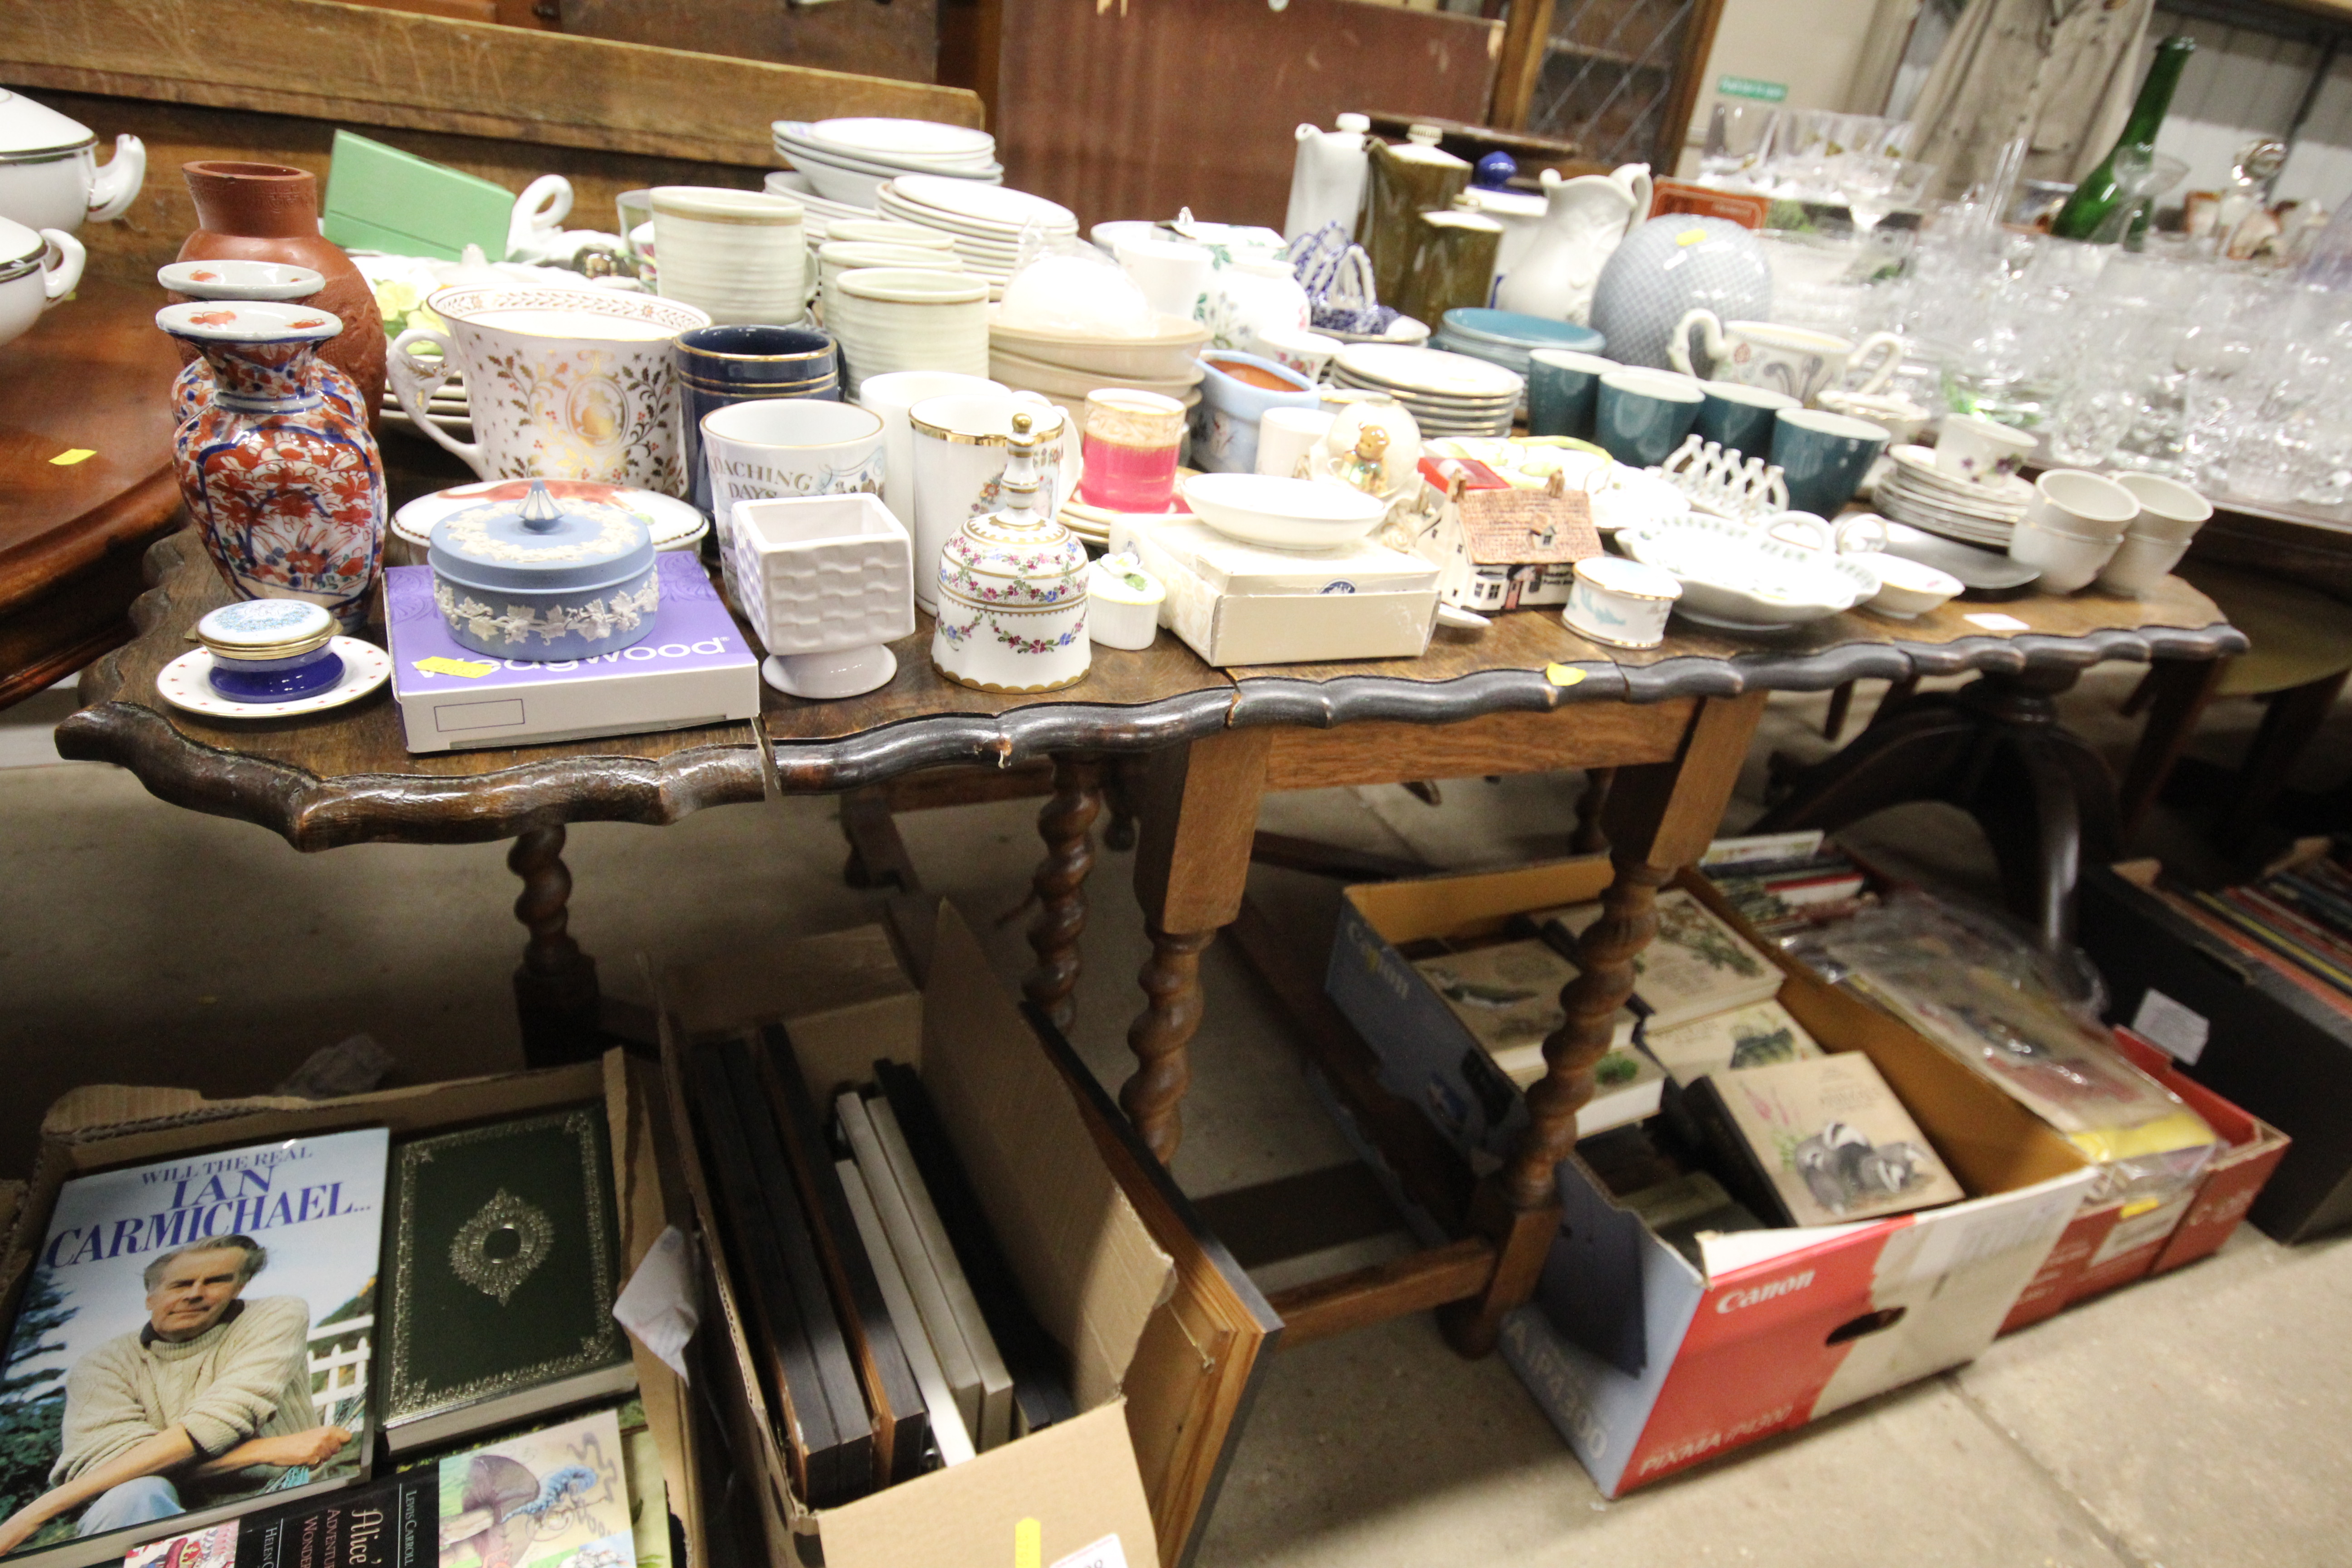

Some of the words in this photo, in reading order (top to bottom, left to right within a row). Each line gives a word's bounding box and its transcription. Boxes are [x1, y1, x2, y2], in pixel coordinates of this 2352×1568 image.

[710, 456, 813, 491] COACHING
[728, 482, 777, 499] DAYS
[142, 1165, 199, 1185] WILL
[203, 1155, 248, 1175] THE
[254, 1147, 313, 1167] REAL
[168, 1164, 279, 1211] IAN
[1715, 1269, 1815, 1314] Canon
[406, 1490, 417, 1520] LEWIS
[263, 1527, 278, 1561] HELEN
[405, 1520, 417, 1566] CARROLL
